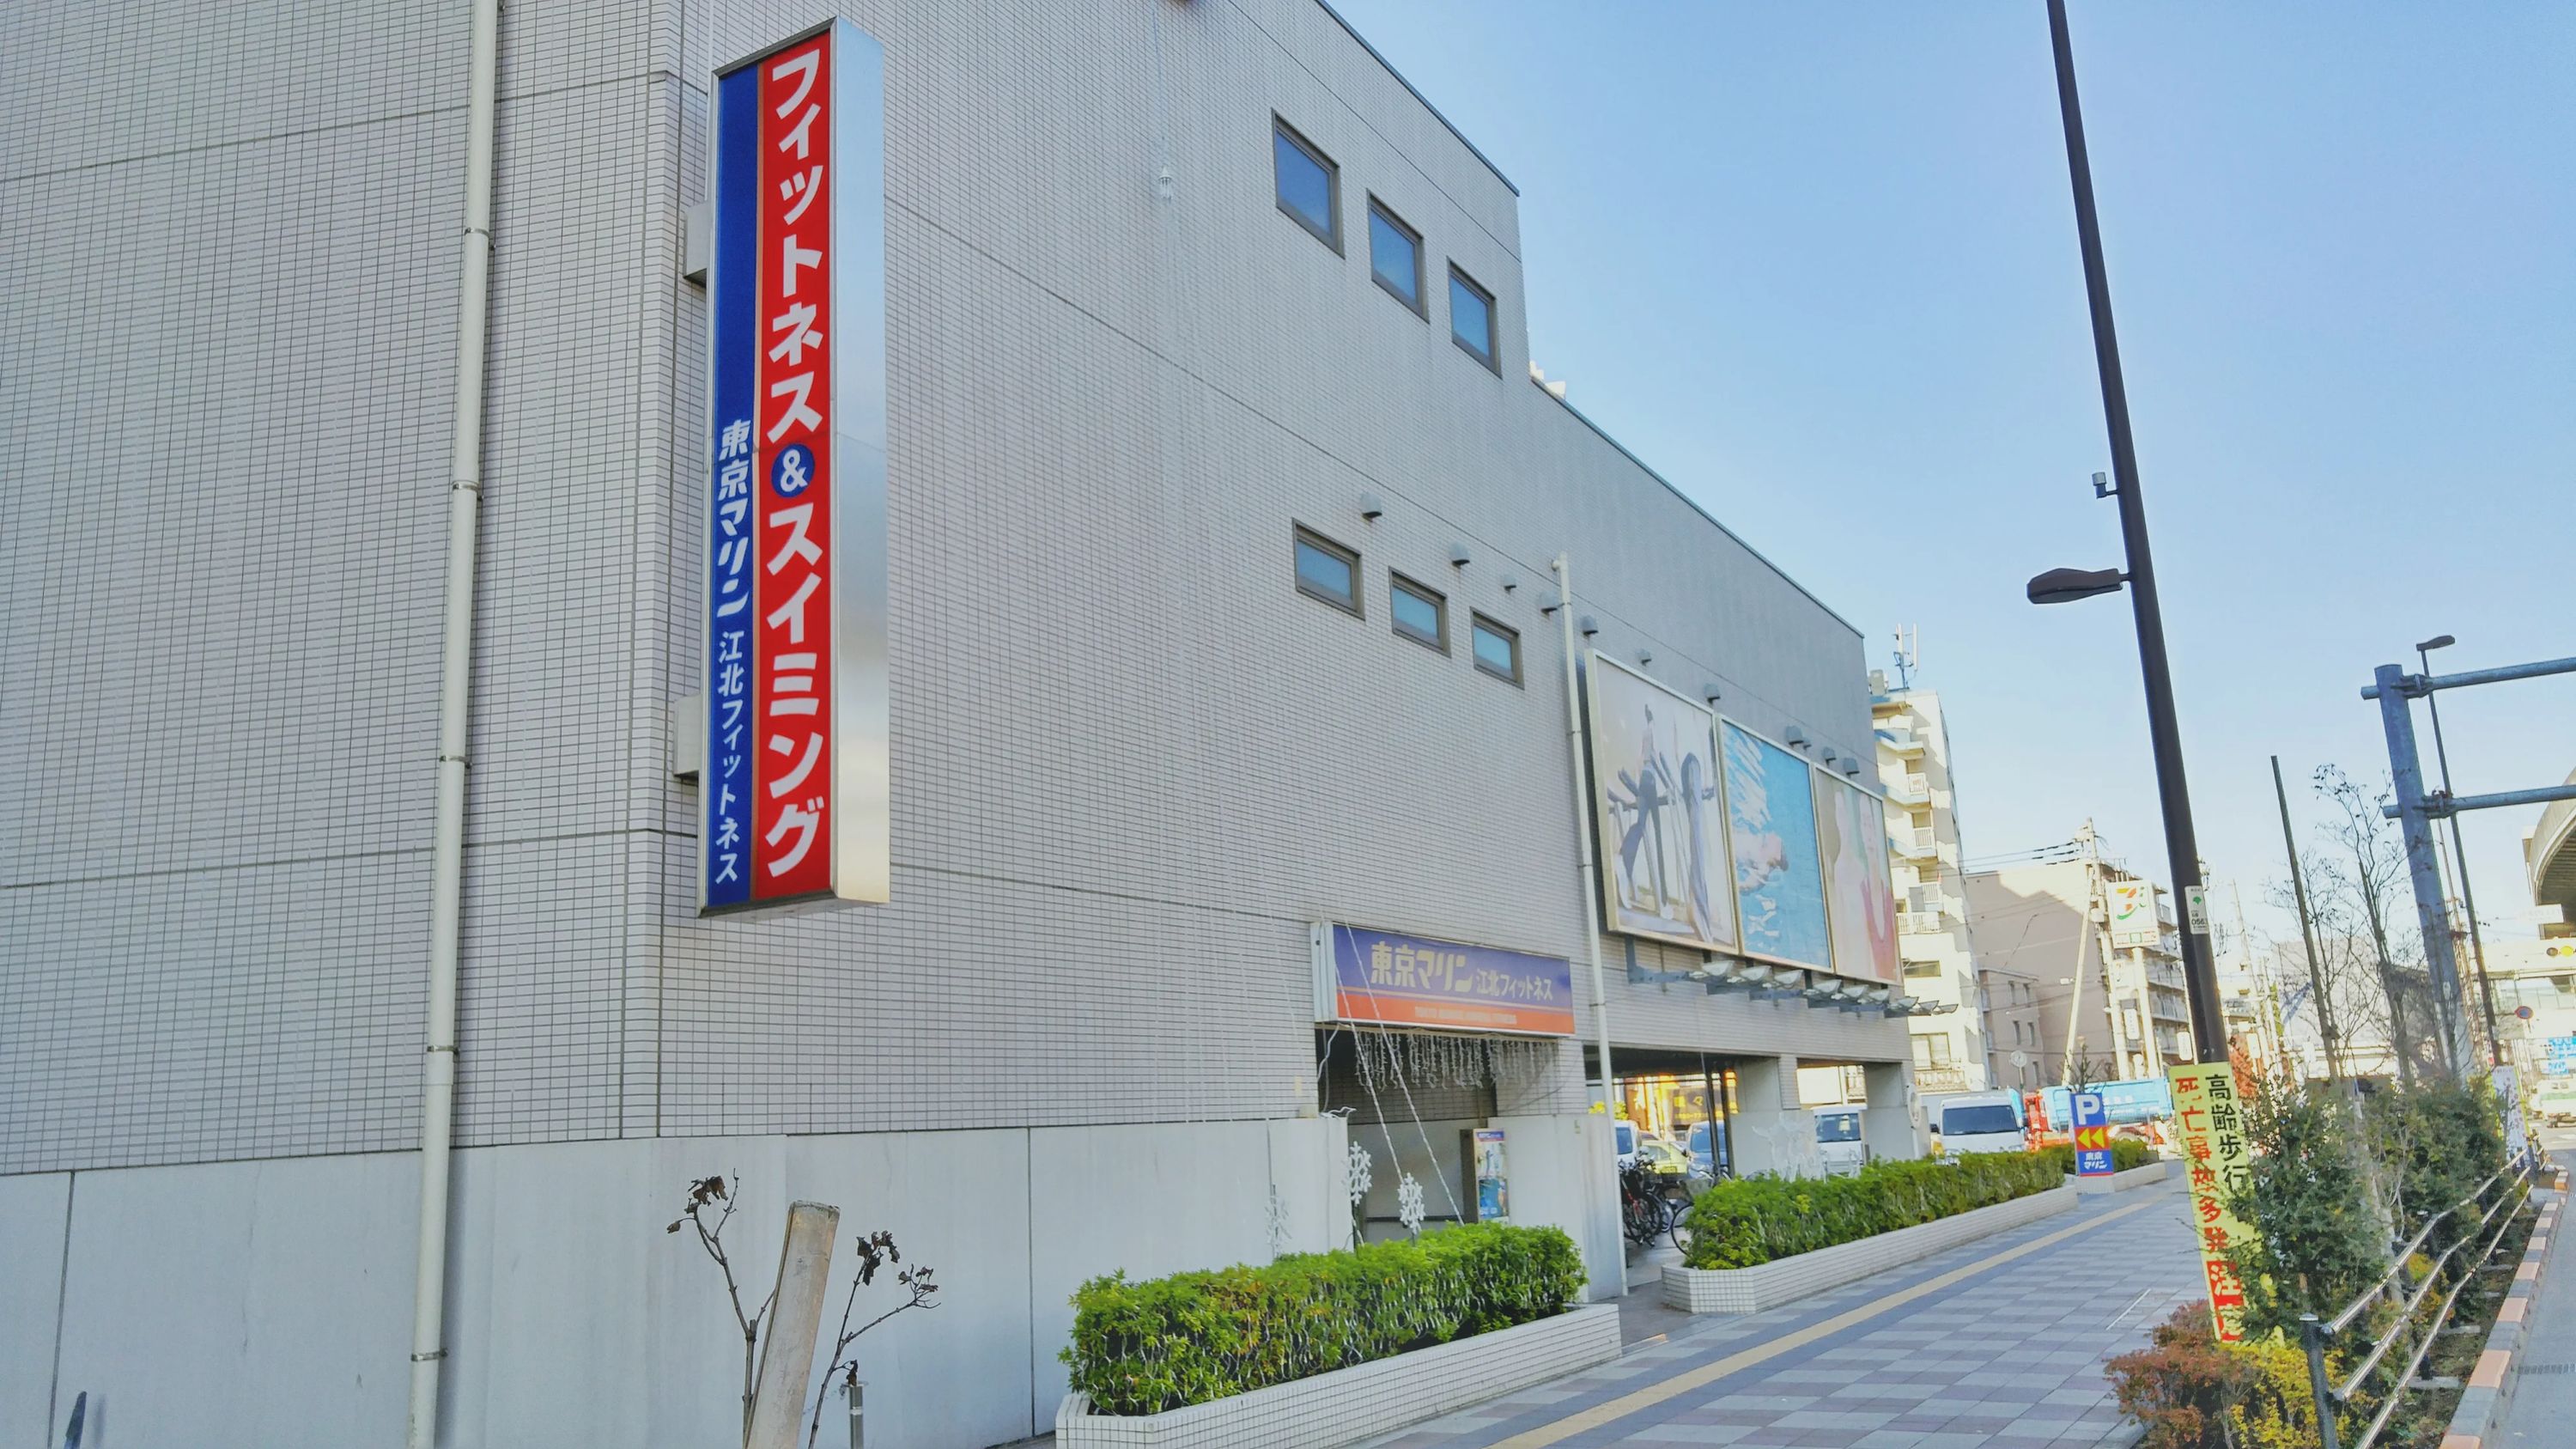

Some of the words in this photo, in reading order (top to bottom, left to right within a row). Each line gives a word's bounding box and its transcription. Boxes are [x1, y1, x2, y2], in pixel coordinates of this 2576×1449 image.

[717, 419, 751, 618] 東京マリン
[714, 631, 745, 885] 江北フィットネス
[1370, 941, 1473, 993] 東京マリン
[1476, 969, 1553, 1002] 江北フィットネス
[2075, 1094, 2100, 1125] P
[2084, 1160, 2107, 1170] マリン
